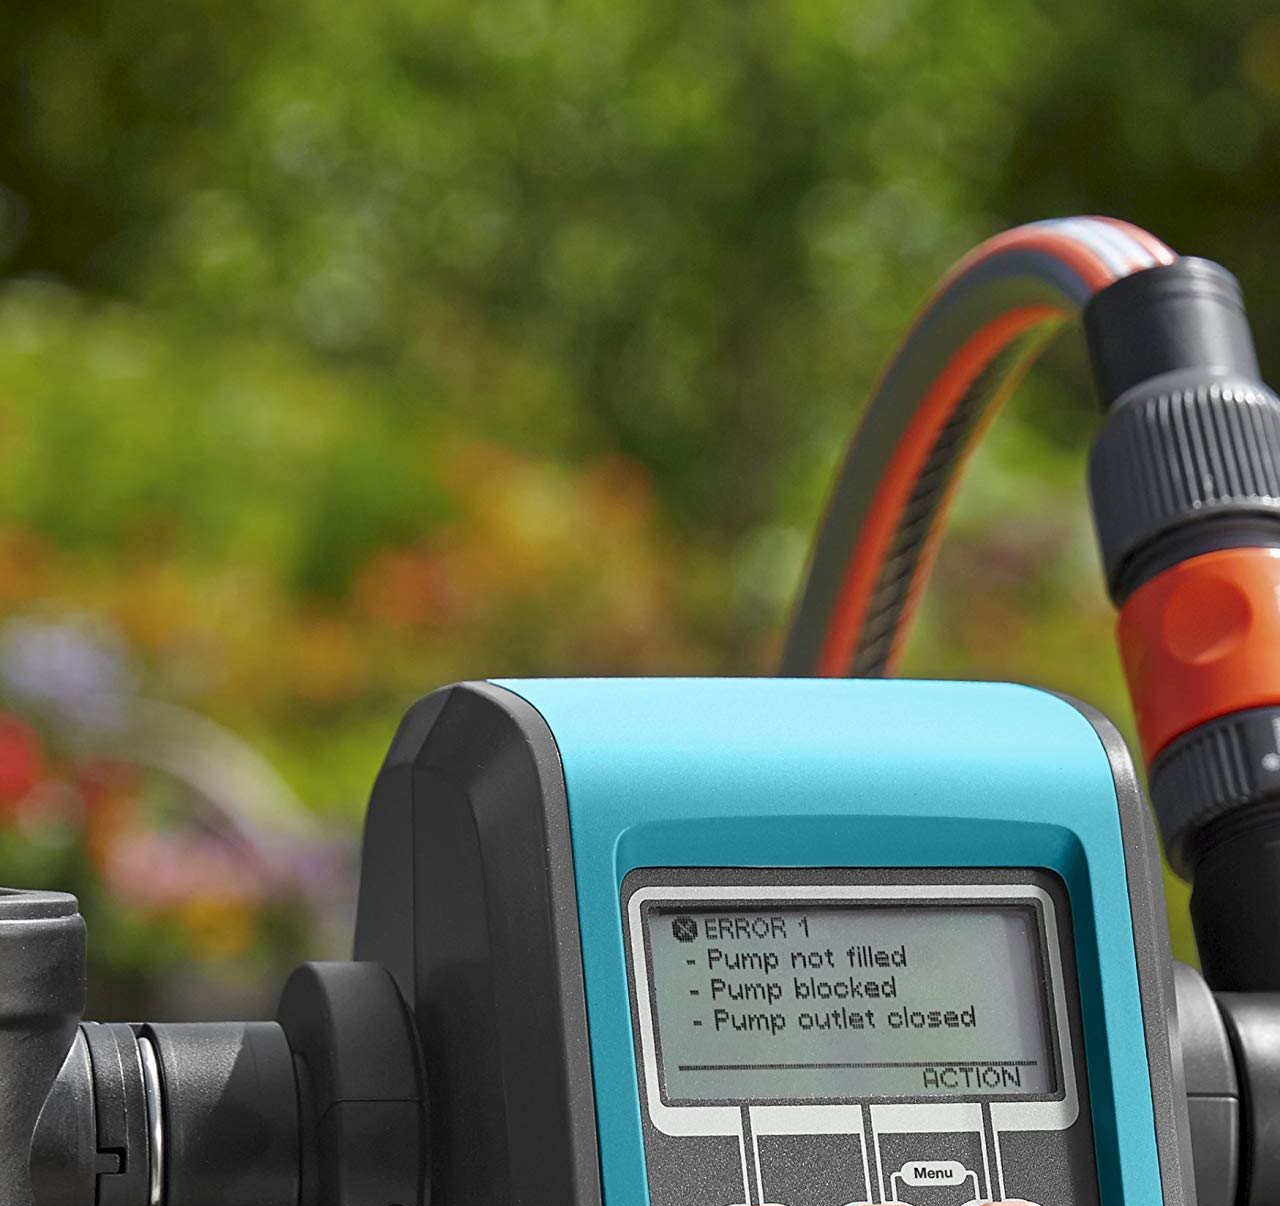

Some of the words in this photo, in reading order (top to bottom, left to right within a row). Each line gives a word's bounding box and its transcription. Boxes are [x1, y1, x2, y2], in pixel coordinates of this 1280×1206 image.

[704, 917, 786, 940] ERROR
[798, 917, 809, 938] 1
[707, 948, 779, 975] Pump
[790, 949, 835, 969] not
[846, 945, 906, 969] filled
[710, 978, 783, 1005] Pump
[794, 975, 896, 999] blocked
[714, 1008, 786, 1036] Pump
[798, 1006, 875, 1030] outlet
[886, 1005, 976, 1029] closed
[922, 1065, 1022, 1090] ACTION
[913, 1166, 954, 1180] Menu
